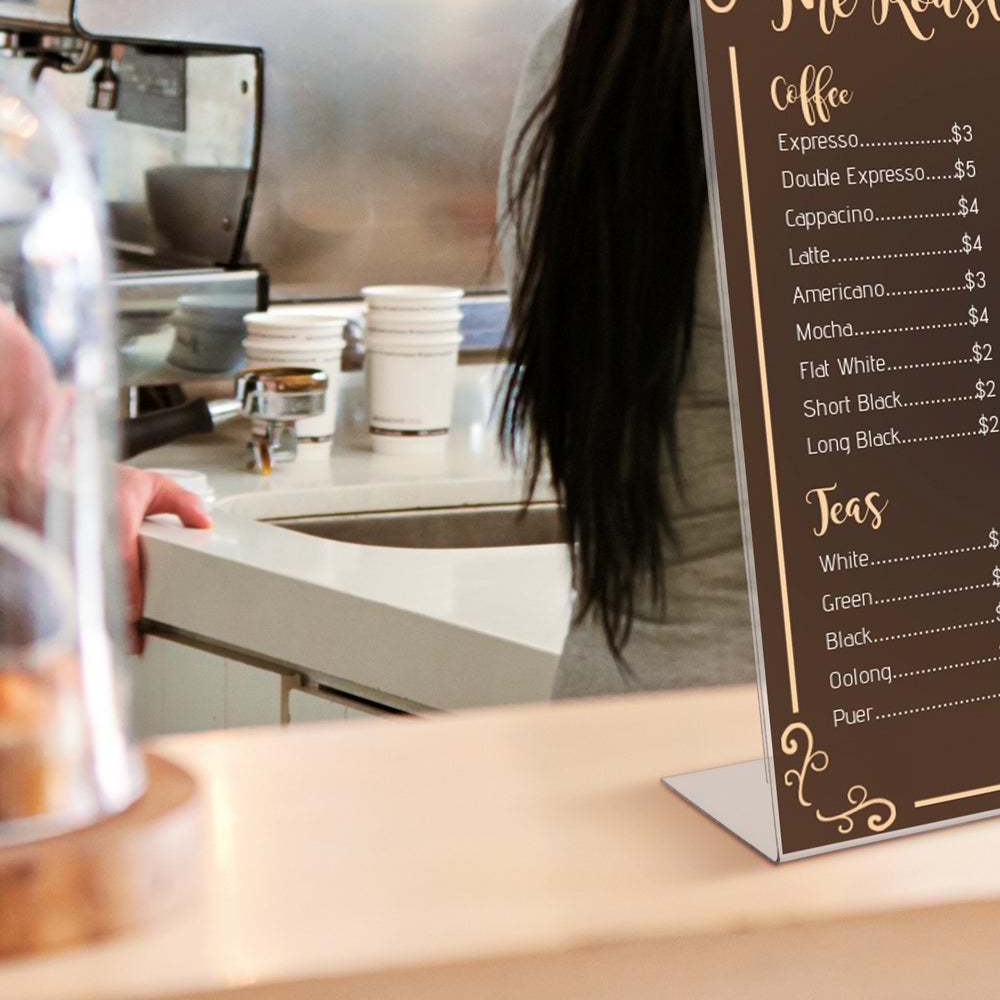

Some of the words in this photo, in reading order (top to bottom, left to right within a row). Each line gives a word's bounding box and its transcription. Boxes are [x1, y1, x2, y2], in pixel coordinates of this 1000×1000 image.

[770, 64, 853, 126] Coffee
[778, 133, 858, 154] Expresso
[951, 123, 973, 144] $3
[782, 167, 841, 189] Double
[847, 167, 925, 187] Expresso
[954, 158, 976, 180] $5
[785, 205, 874, 230] Cappacino
[958, 195, 979, 217] $4
[789, 247, 830, 266] Latte
[962, 232, 983, 254] $4
[792, 281, 885, 305] Americano
[965, 269, 986, 291] $3
[796, 321, 853, 341] Mocha
[969, 305, 989, 327] $4
[800, 360, 830, 380] Flat
[837, 356, 886, 376] White
[972, 342, 993, 364] $2
[803, 395, 851, 418] Short
[857, 391, 903, 411] Black
[975, 378, 996, 400] $2
[807, 436, 850, 455] Long
[856, 428, 902, 448] Black
[978, 414, 1000, 436] $2
[805, 482, 889, 537] Teas
[819, 551, 869, 573] White
[822, 592, 873, 612] Green
[826, 628, 873, 650] Black
[829, 666, 892, 690] Oolong
[833, 707, 874, 728] Puer
